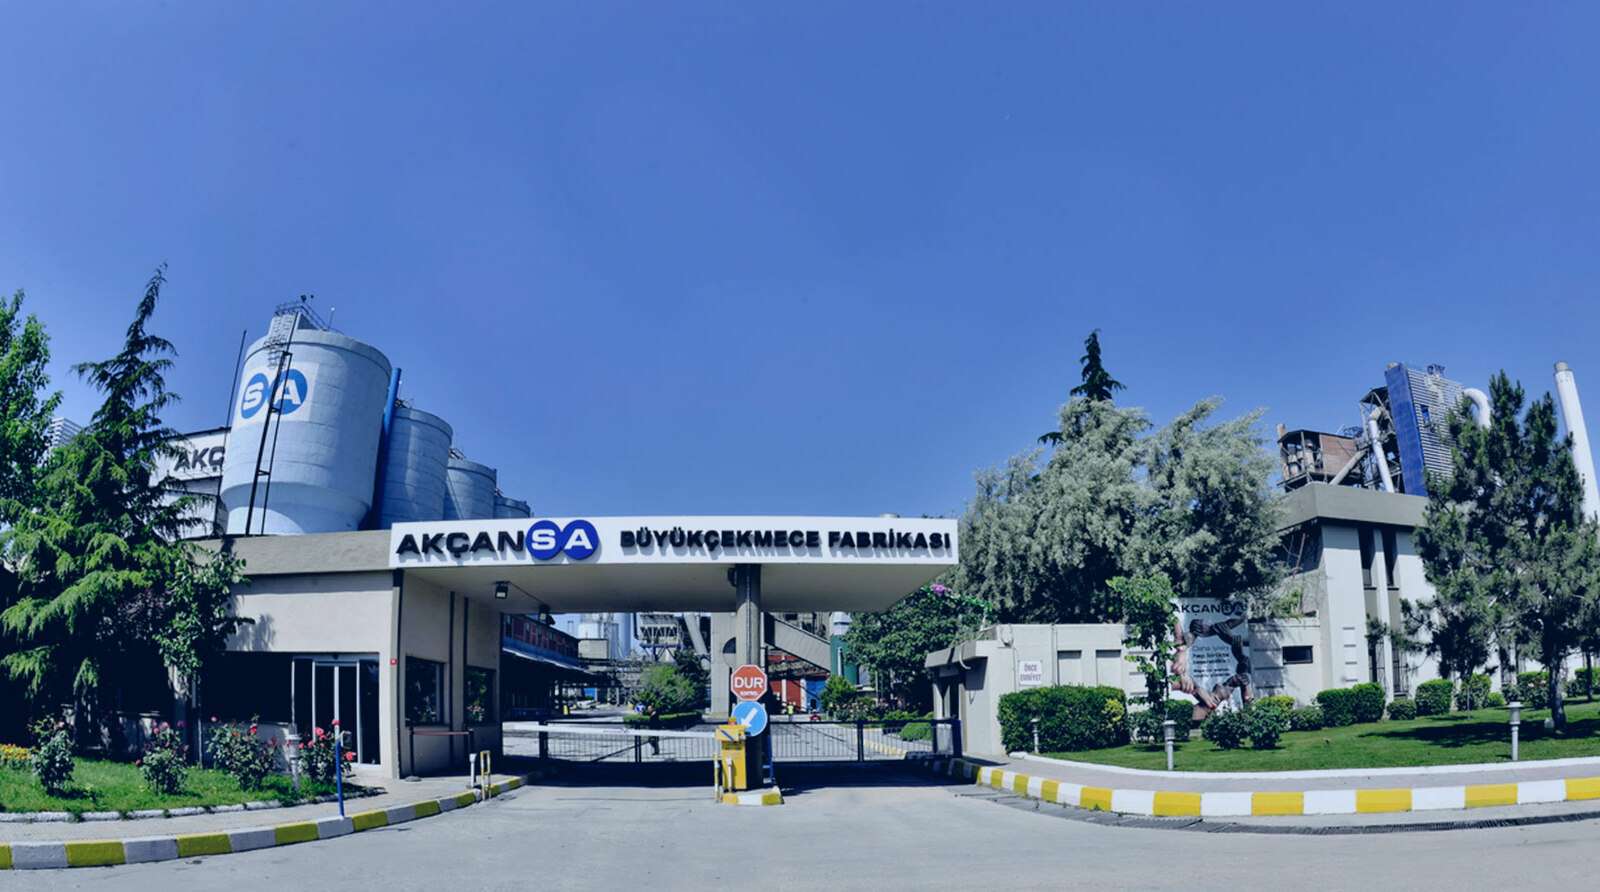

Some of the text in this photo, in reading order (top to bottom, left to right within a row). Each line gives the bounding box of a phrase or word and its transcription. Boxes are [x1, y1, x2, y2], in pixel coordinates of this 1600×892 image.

[241, 378, 302, 412] SA
[396, 528, 593, 559] AKÇANSA
[620, 527, 951, 552] BÜYÜKÇEKMECE FABRİKASI
[734, 676, 764, 688] DUR
